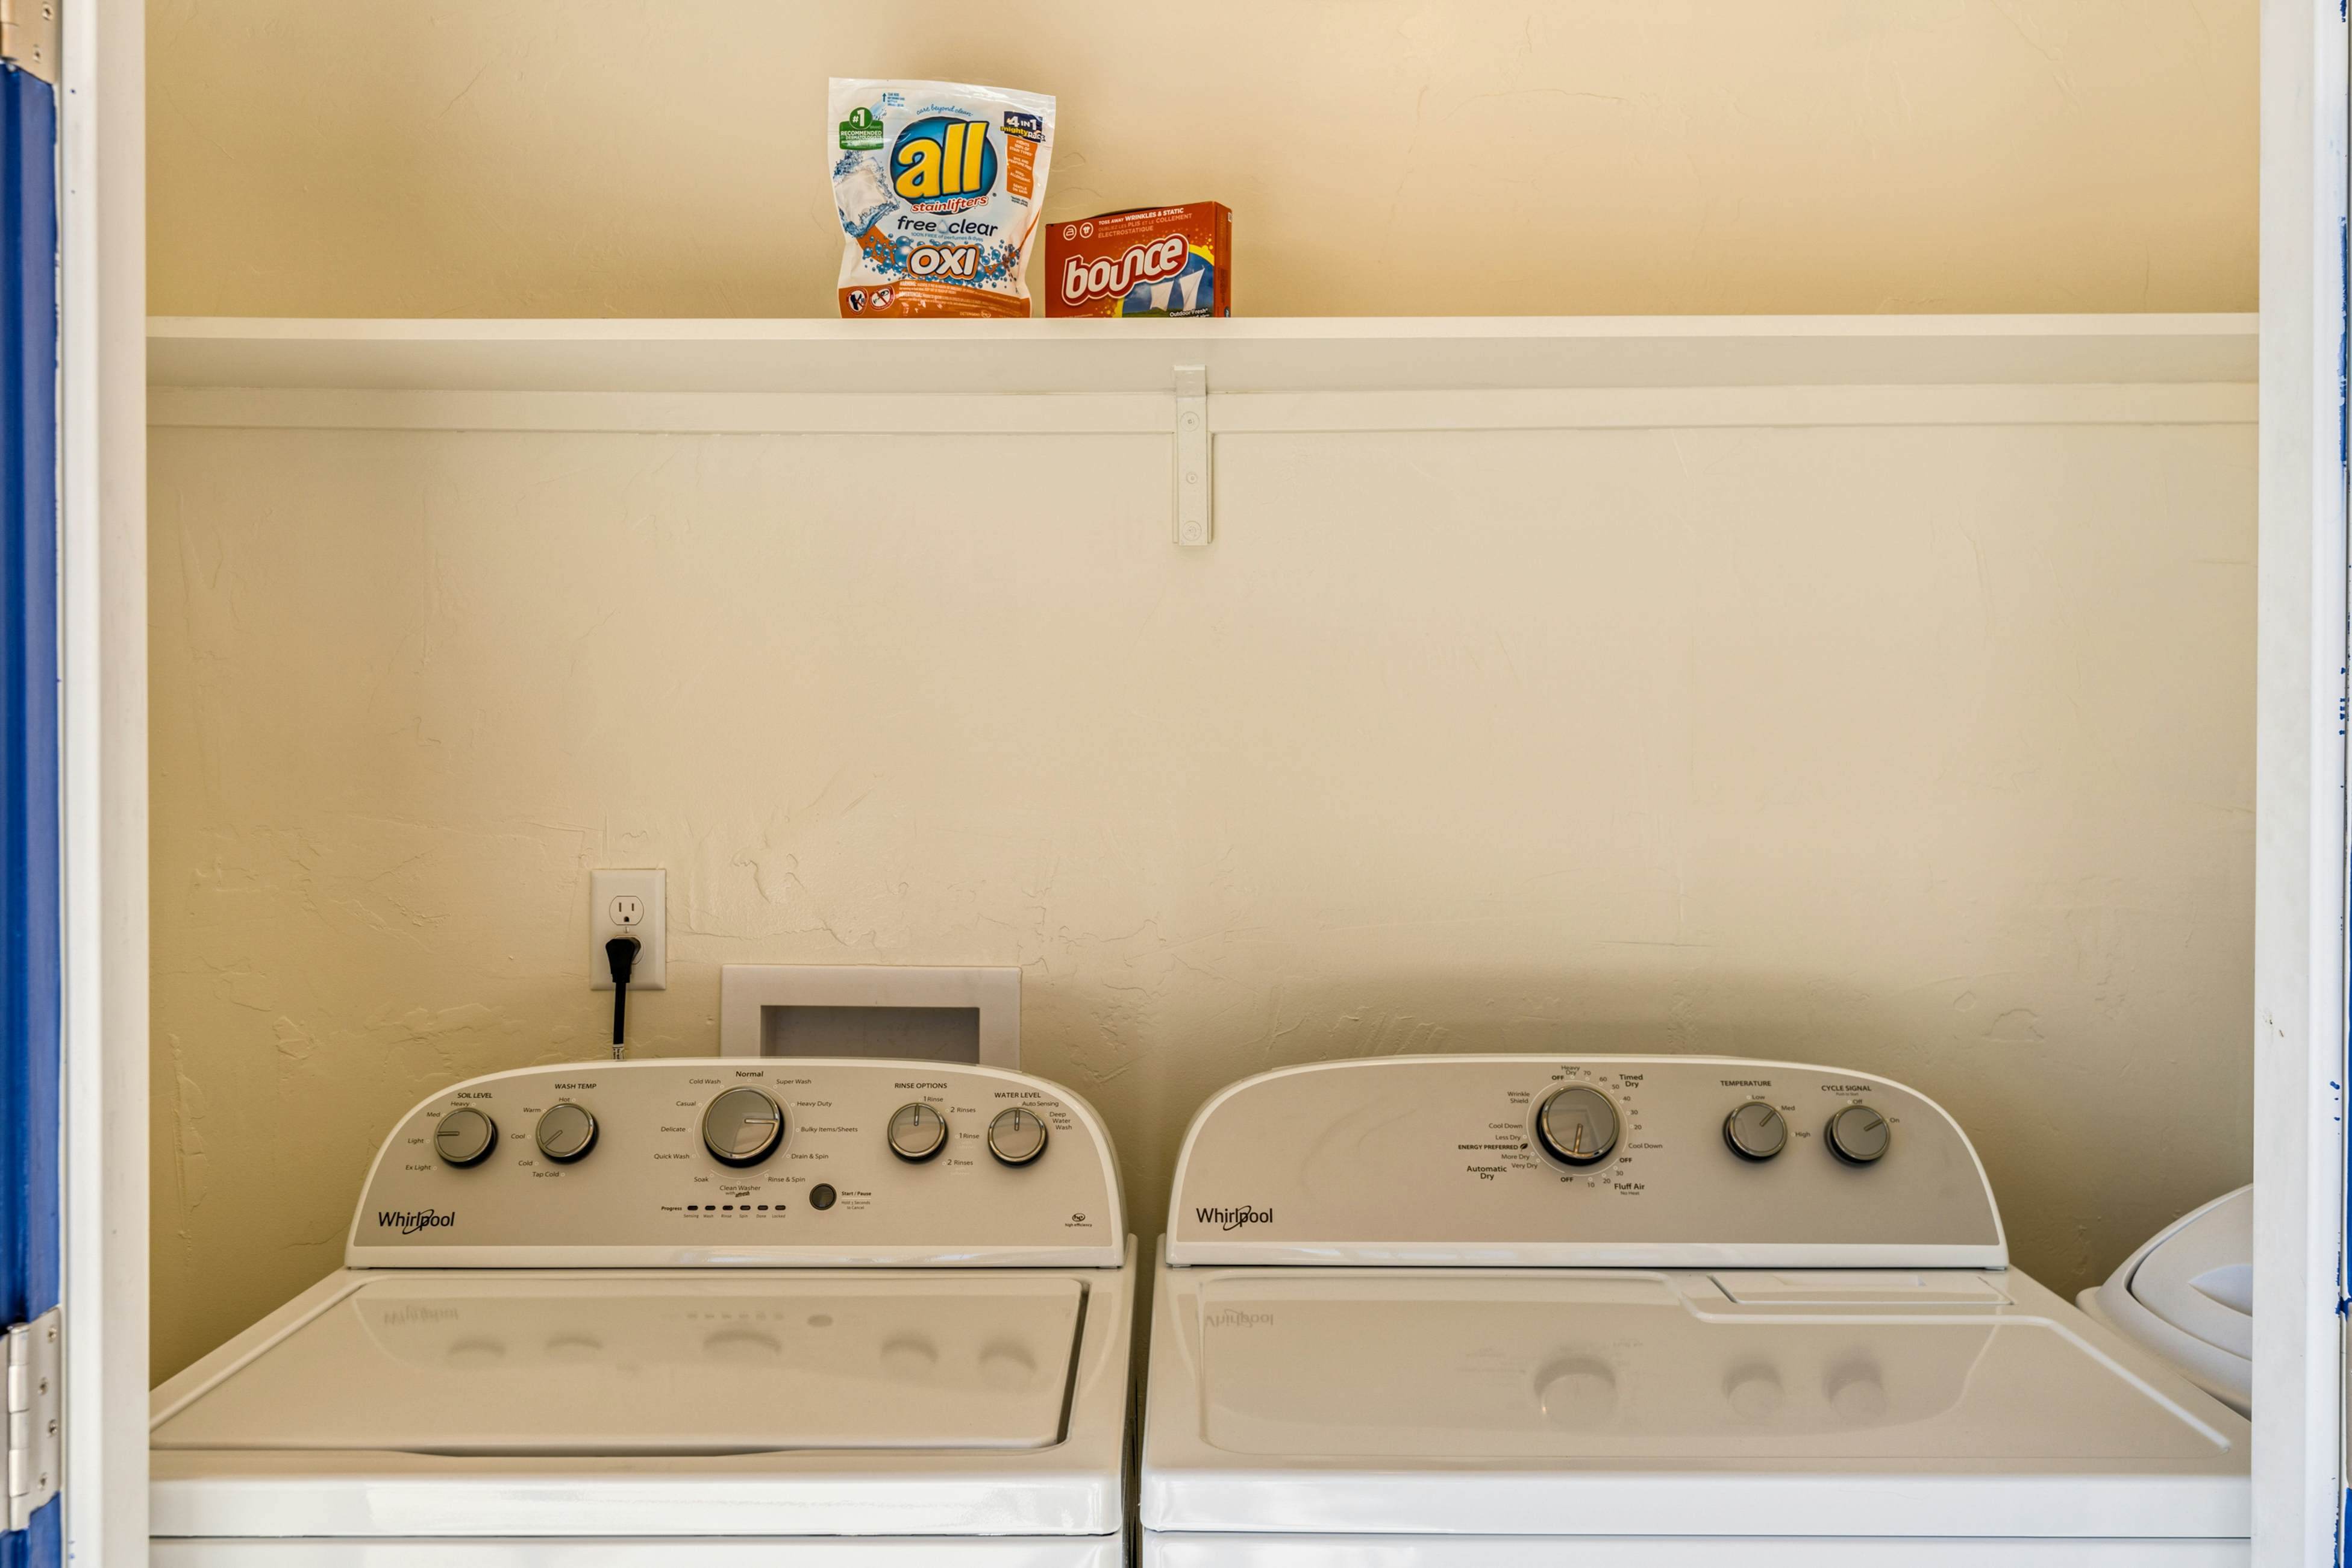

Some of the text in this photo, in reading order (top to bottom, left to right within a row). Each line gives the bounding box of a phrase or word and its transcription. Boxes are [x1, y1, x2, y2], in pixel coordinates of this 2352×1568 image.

[852, 109, 865, 127] #1
[931, 104, 955, 114] beyond
[1007, 116, 1019, 127] 4
[1030, 119, 1037, 131] 1
[895, 122, 989, 199] all
[912, 196, 987, 213] stainlifters
[1125, 212, 1157, 221] WRINKLES
[1163, 208, 1184, 216] STATIC
[1156, 213, 1192, 223] COLLEMENT
[897, 216, 998, 237] free clear
[1098, 225, 1154, 239] ÉLECTROSTATIQUE
[910, 248, 976, 275] OXI
[1065, 237, 1183, 299] bounce
[378, 1210, 455, 1233] Whirlpool
[1196, 1207, 1273, 1229] Whirlpool
